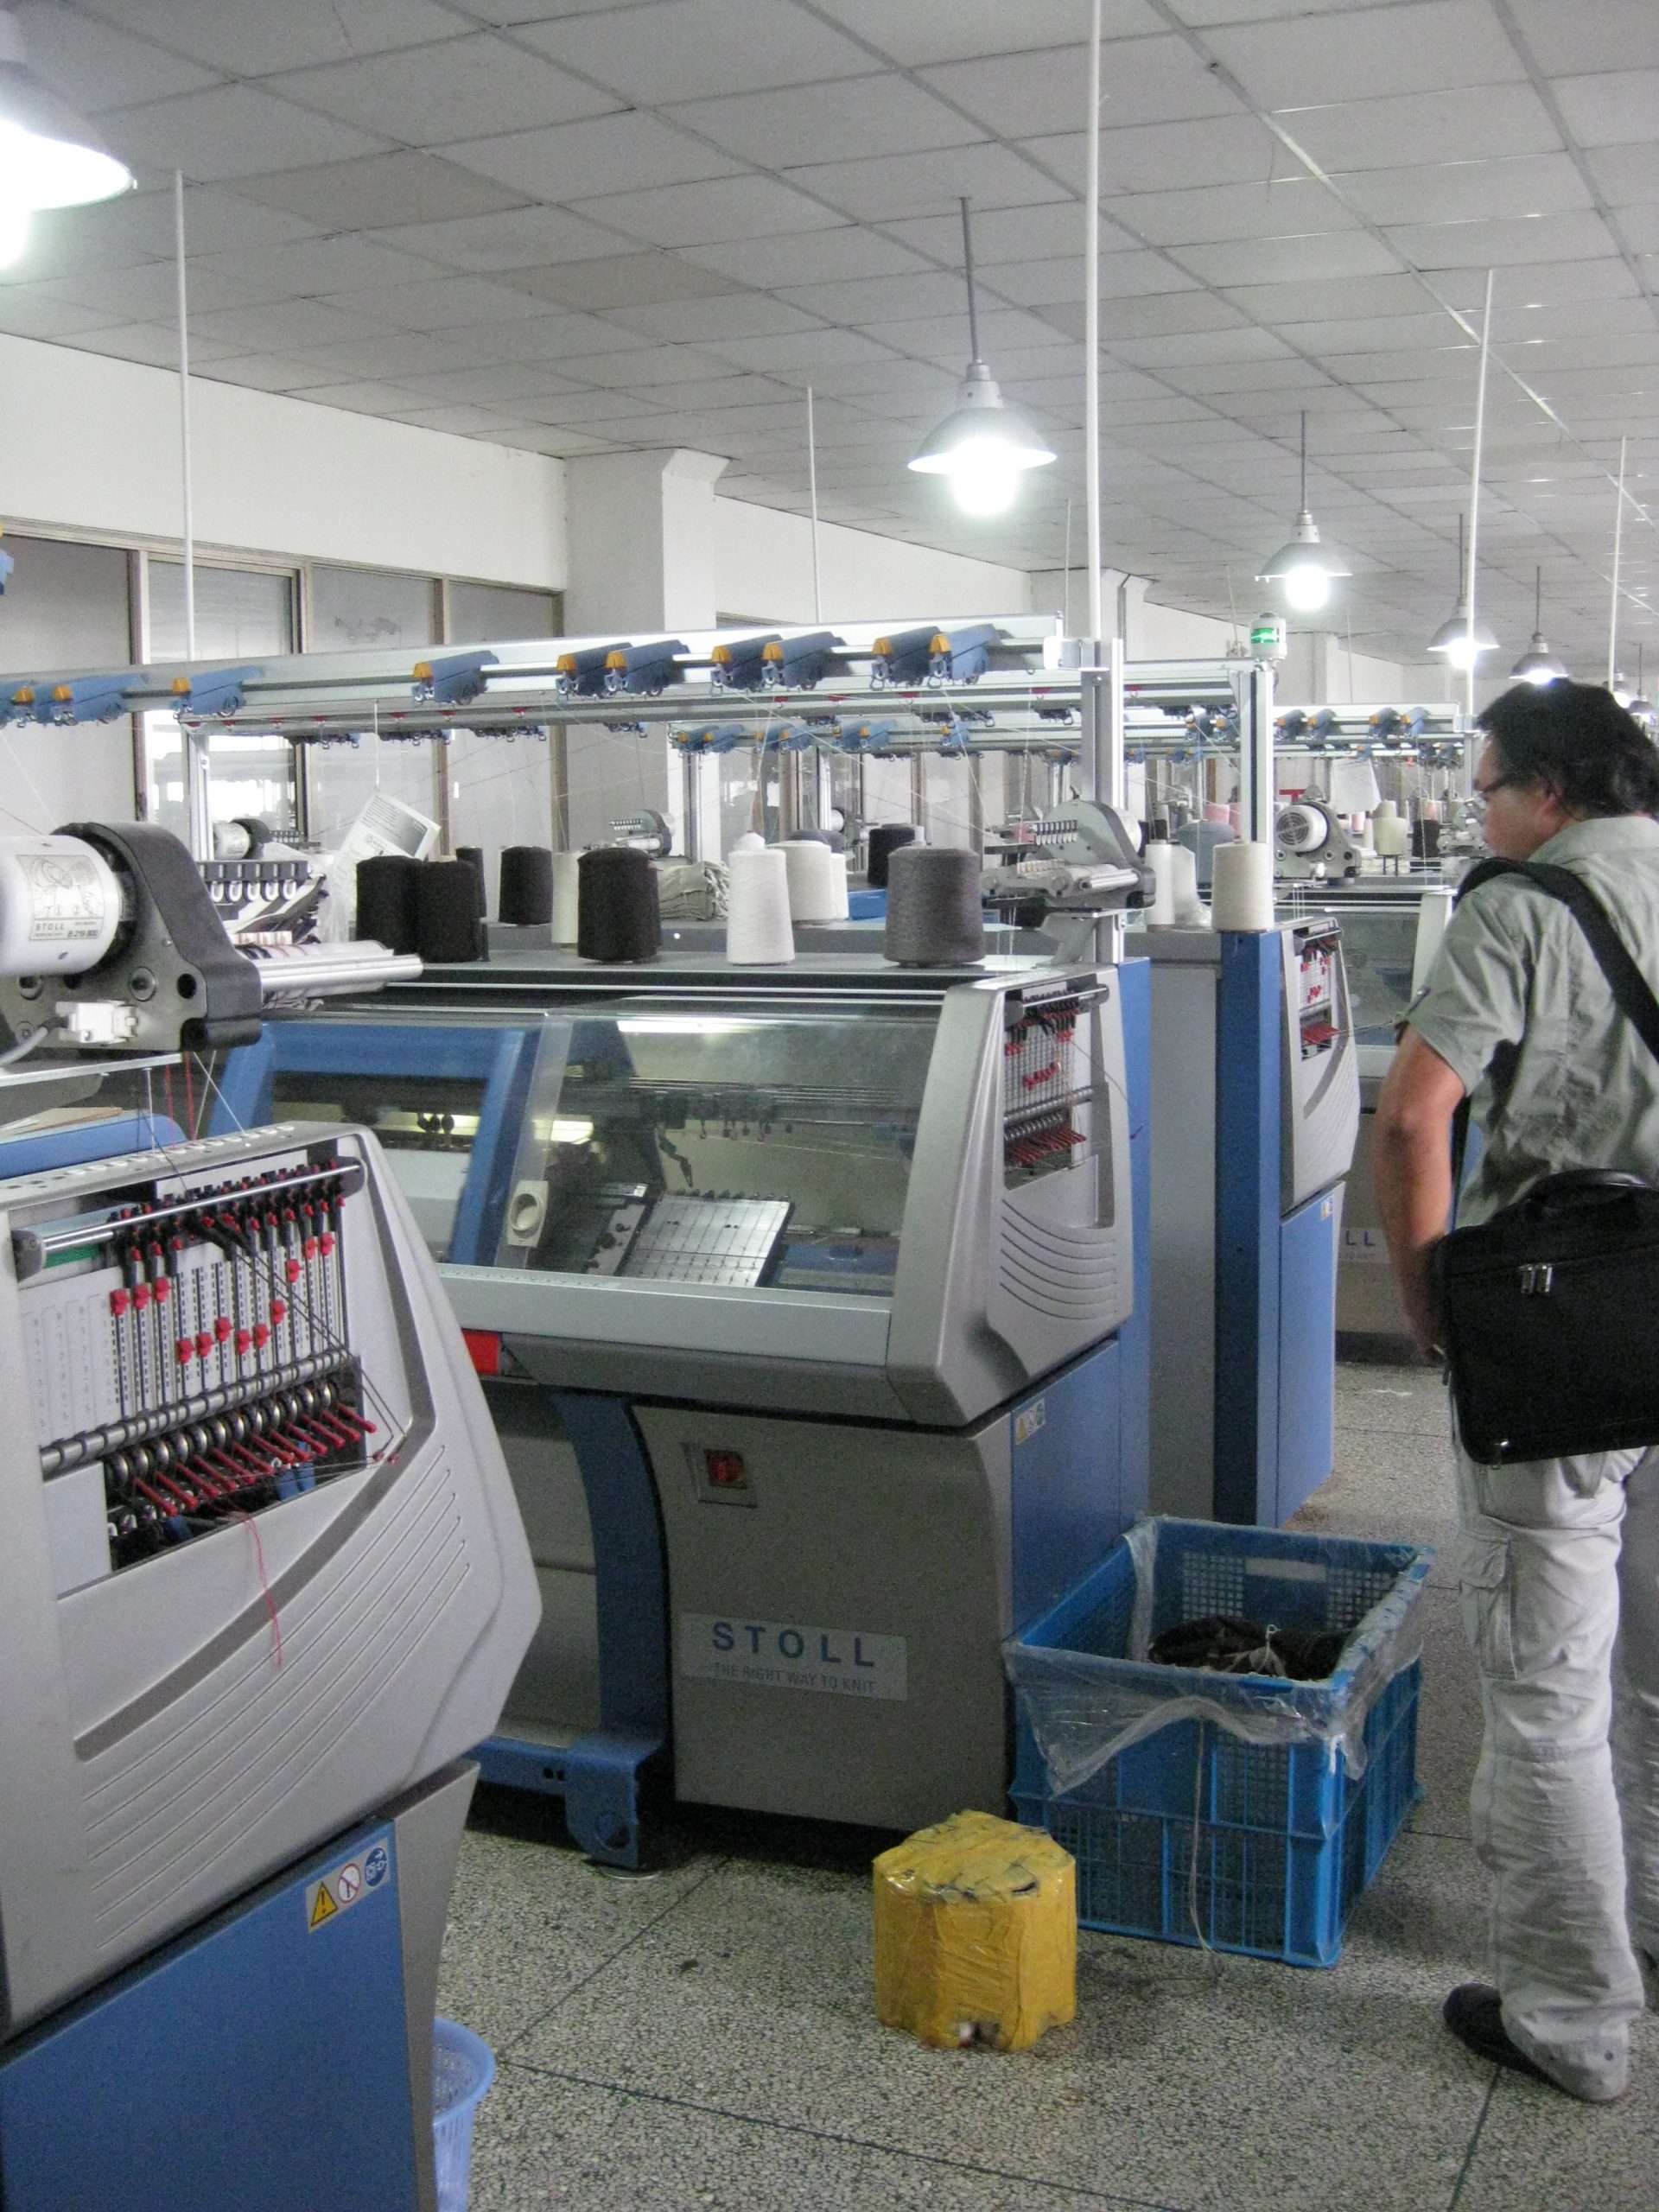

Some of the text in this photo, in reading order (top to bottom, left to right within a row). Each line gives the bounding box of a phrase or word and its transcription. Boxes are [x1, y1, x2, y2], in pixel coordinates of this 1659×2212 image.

[35, 922, 65, 931] STOLL
[712, 1621, 874, 1668] STOLL
[713, 1662, 876, 1694] THE RIGHT WAY TO KNIT
